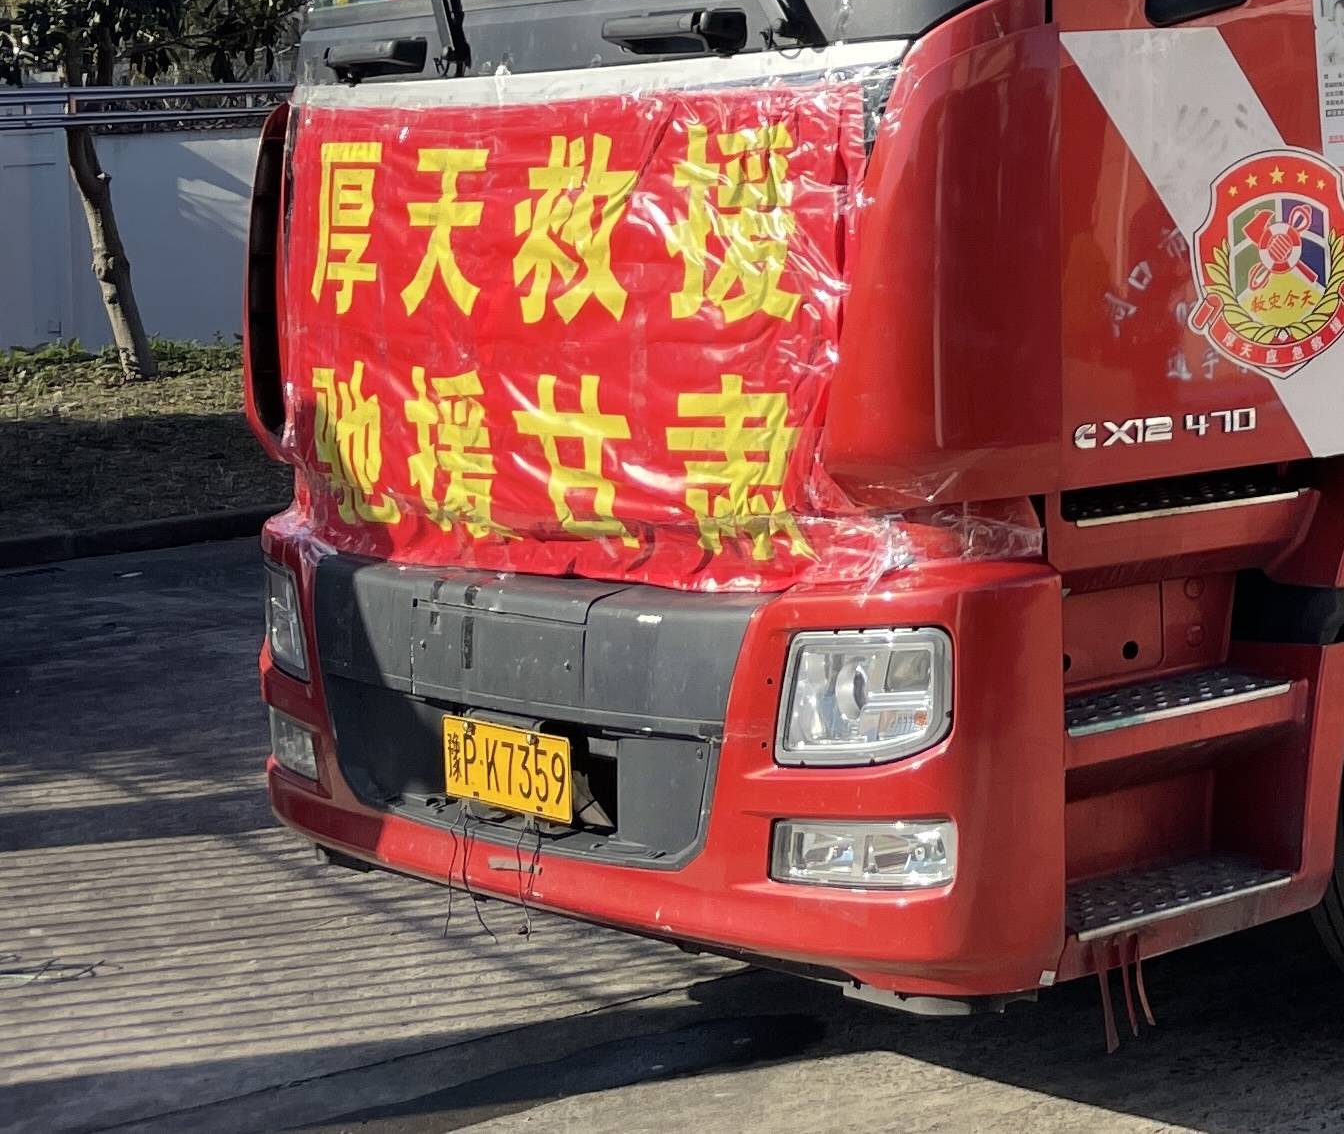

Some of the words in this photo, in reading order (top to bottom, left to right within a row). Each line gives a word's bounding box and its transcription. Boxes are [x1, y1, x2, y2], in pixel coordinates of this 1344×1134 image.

[311, 124, 804, 324] 厚天救援
[311, 360, 822, 562] 驰援甘肃
[1185, 408, 1256, 436] 470
